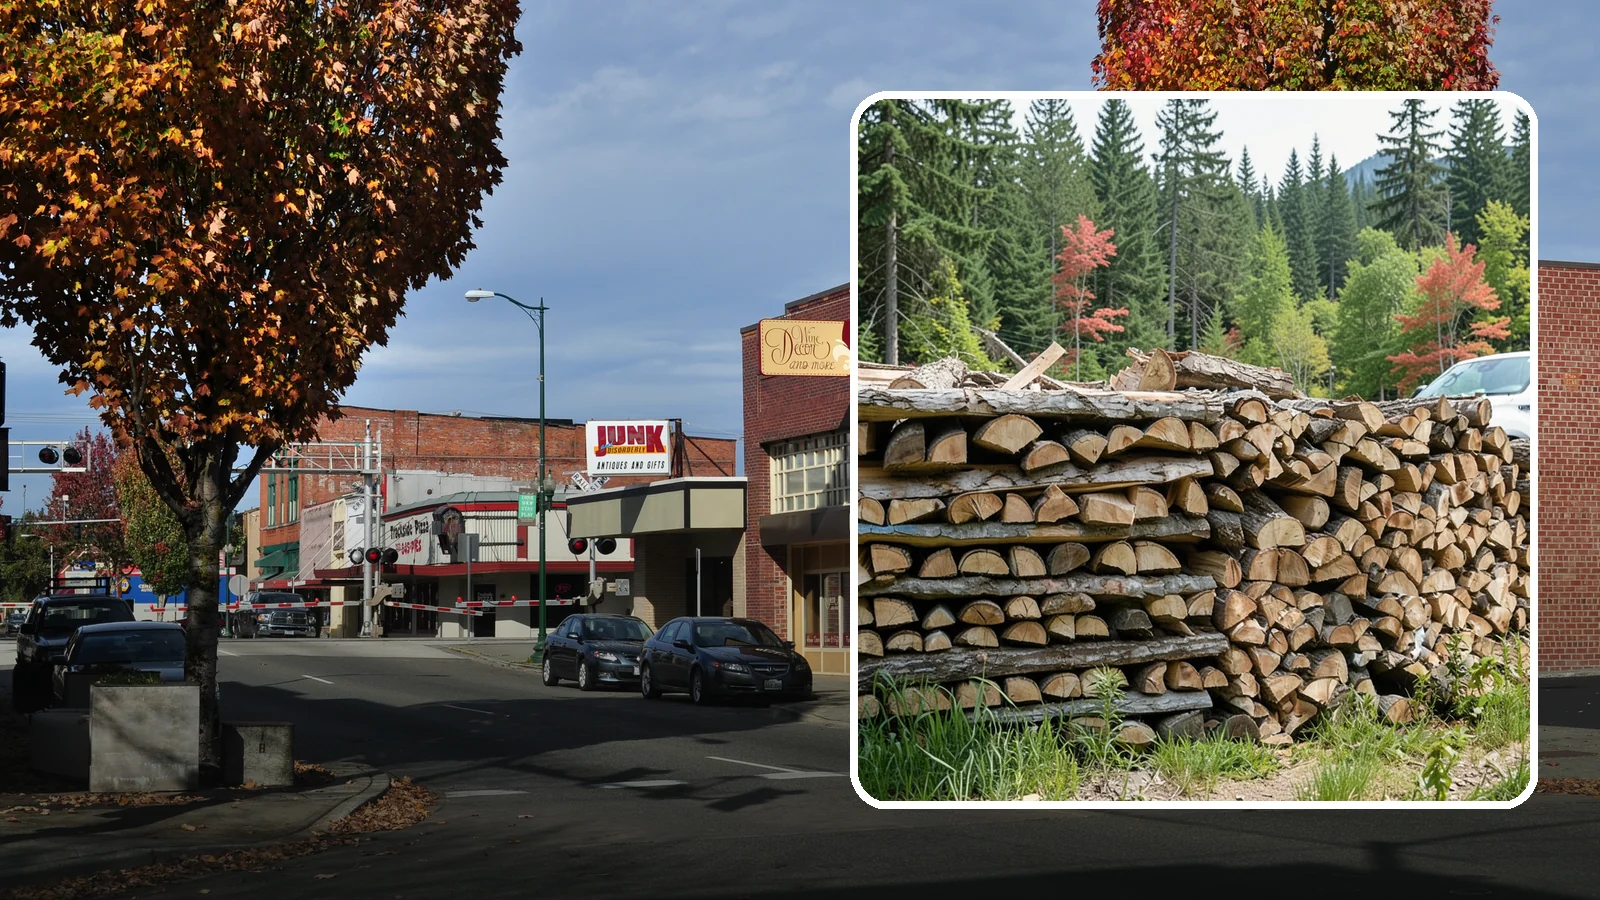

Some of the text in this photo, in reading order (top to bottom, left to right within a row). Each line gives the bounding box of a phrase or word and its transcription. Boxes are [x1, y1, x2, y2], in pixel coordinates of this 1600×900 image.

[595, 425, 665, 457] JUNK
[607, 446, 646, 454] DISORDERLY
[596, 460, 665, 470] ANTIQUES AND GIFTS
[390, 519, 429, 540] Trackside Pizza
